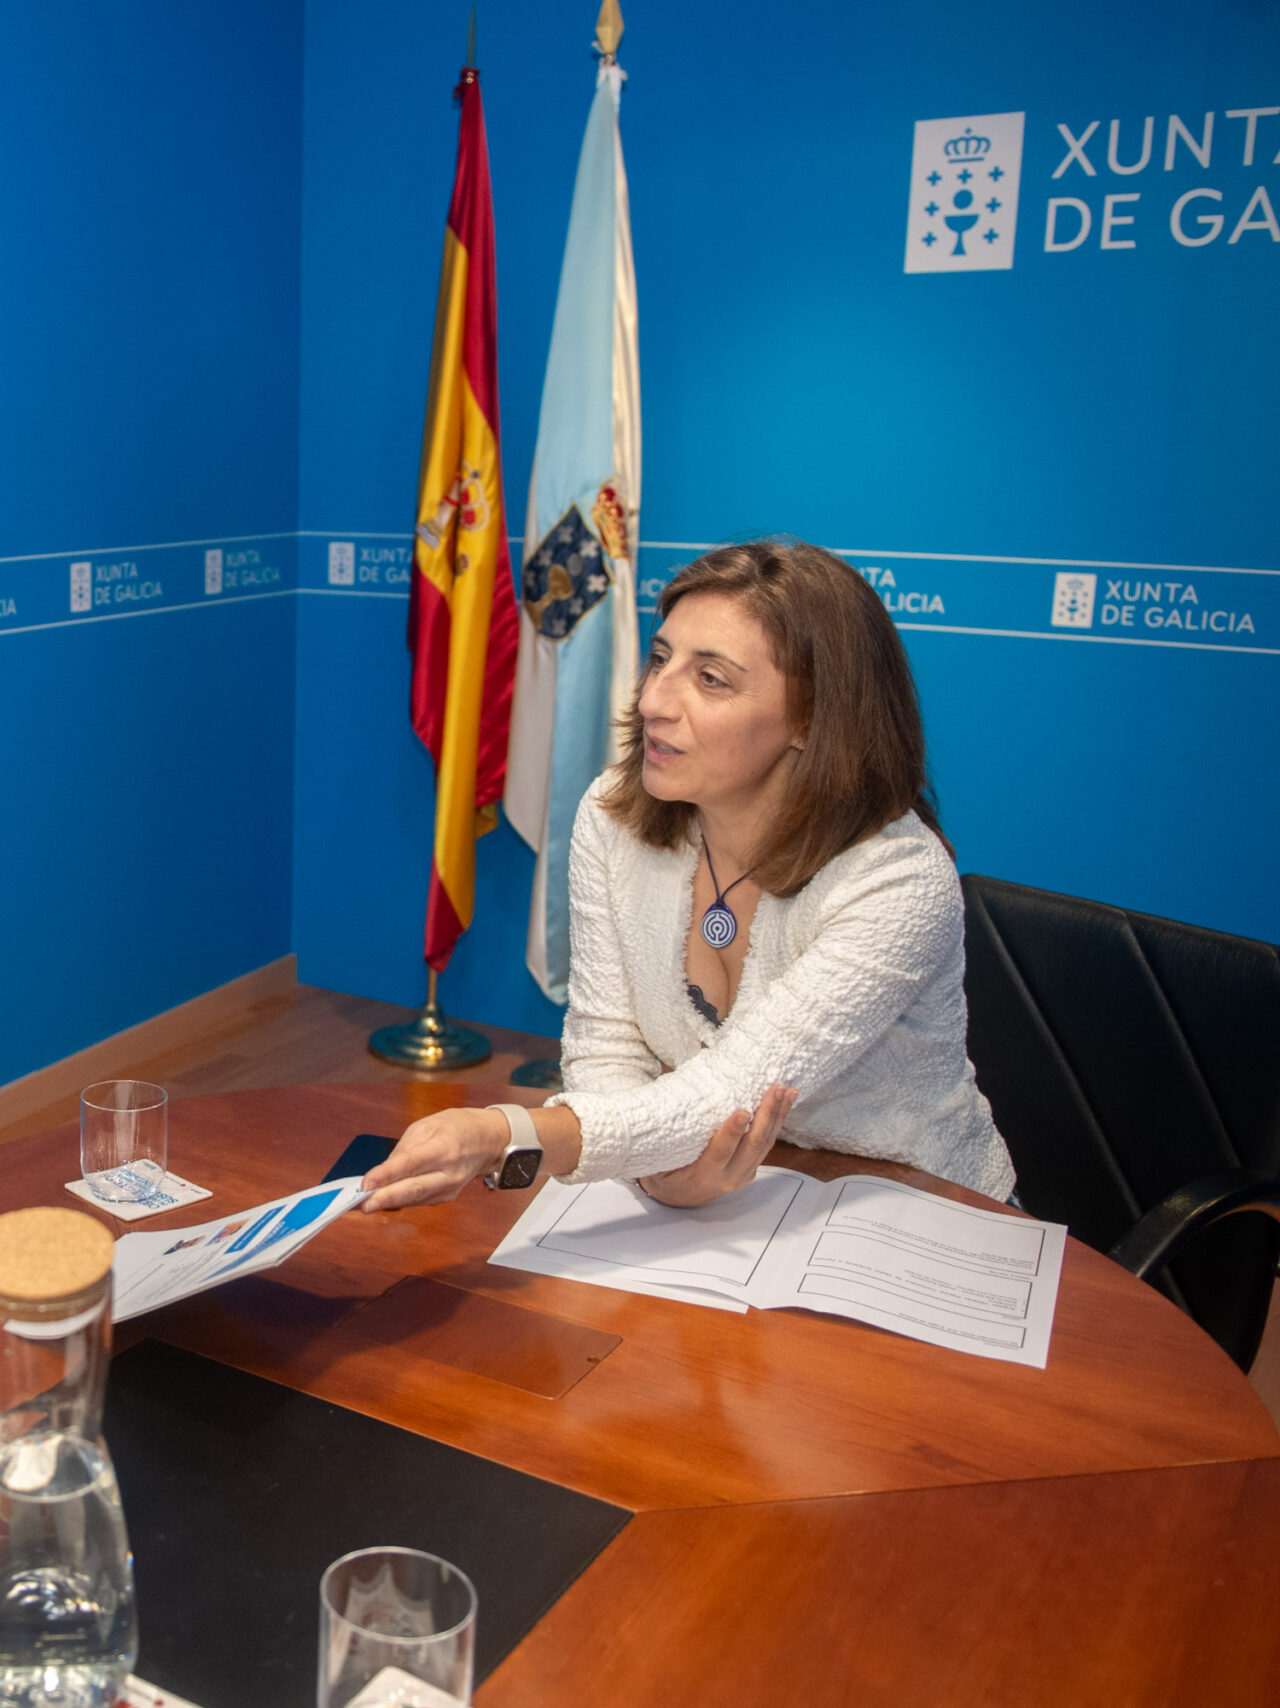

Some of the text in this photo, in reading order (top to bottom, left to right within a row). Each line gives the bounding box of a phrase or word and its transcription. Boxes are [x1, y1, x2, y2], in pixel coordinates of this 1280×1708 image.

[1044, 185, 1280, 252] DE GA
[95, 562, 139, 583] XUNTA
[359, 566, 379, 583] DE
[95, 582, 163, 606] DE GALICIA
[883, 591, 946, 614] LICIA
[1105, 580, 1199, 605] XUNTA
[1101, 603, 1256, 634] DE GALICIA
